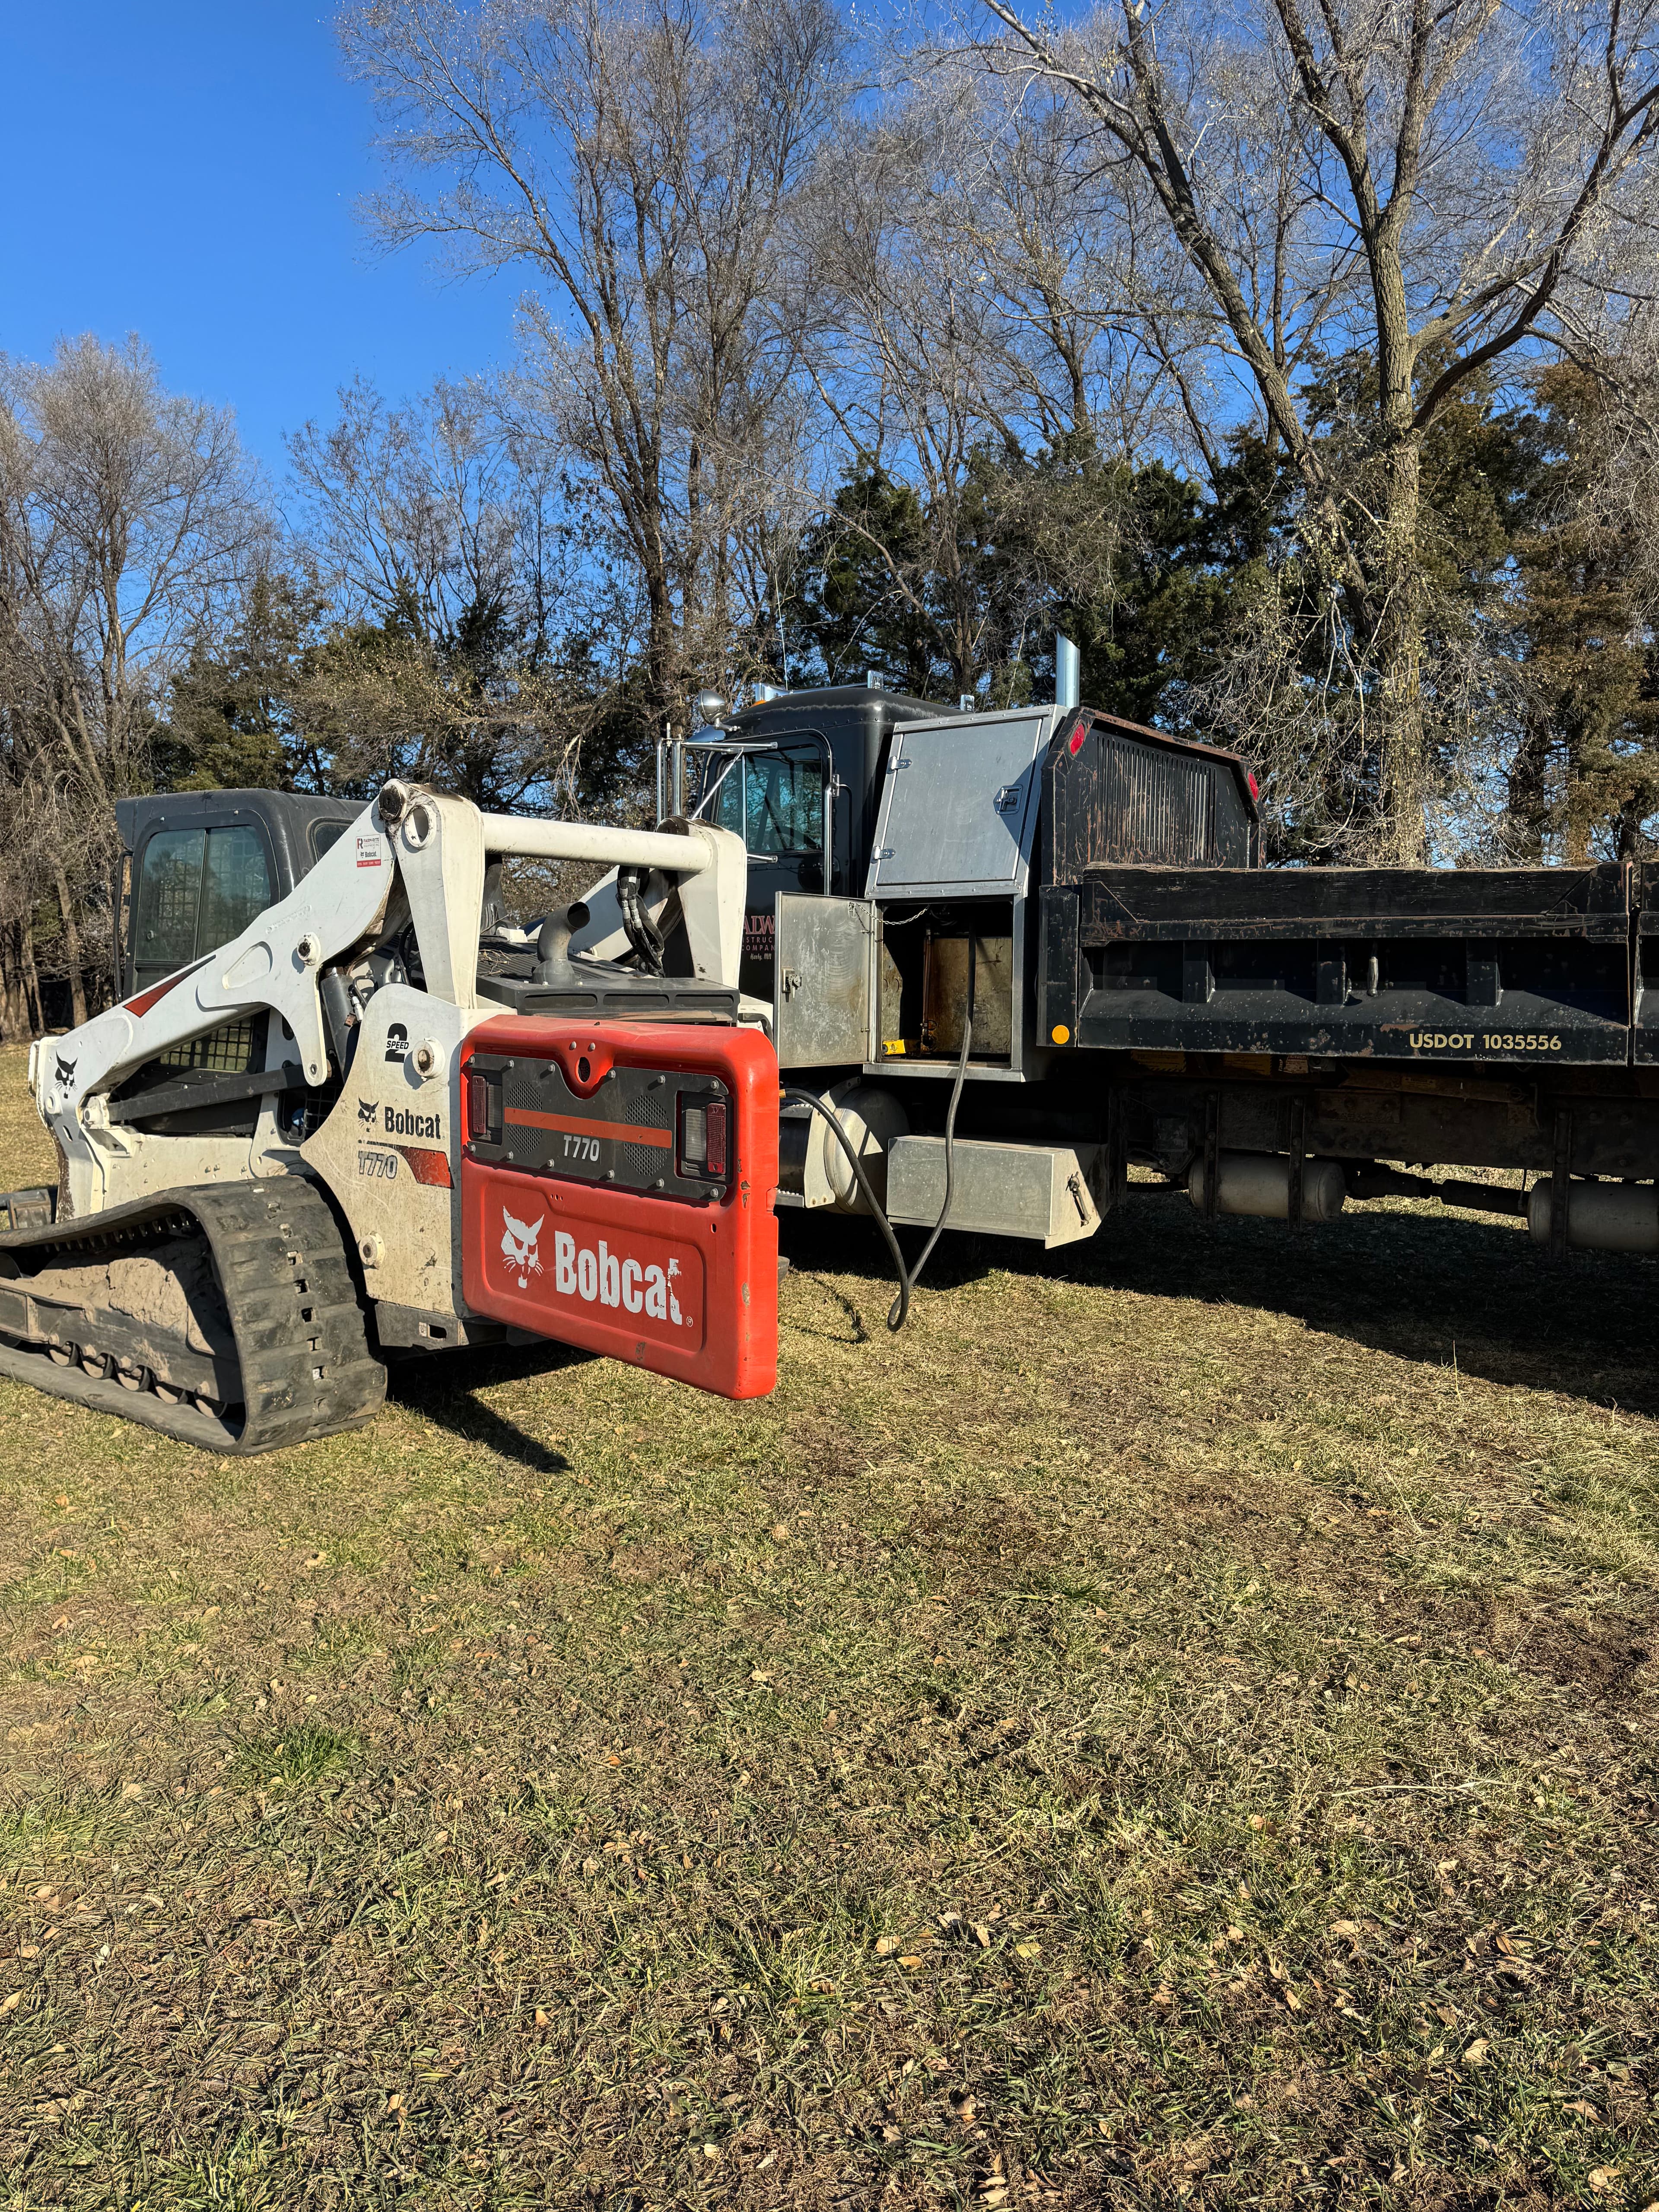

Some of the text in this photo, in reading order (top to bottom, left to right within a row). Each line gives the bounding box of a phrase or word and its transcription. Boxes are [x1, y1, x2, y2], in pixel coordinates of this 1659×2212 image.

[385, 1023, 408, 1063] 2
[386, 1040, 409, 1049] SPEED
[1410, 1033, 1562, 1050] USDOT 1035556
[385, 1106, 441, 1139] Bobcat
[563, 1135, 600, 1161] T770
[358, 1150, 398, 1179] T770
[555, 1230, 682, 1325] Bobcat
